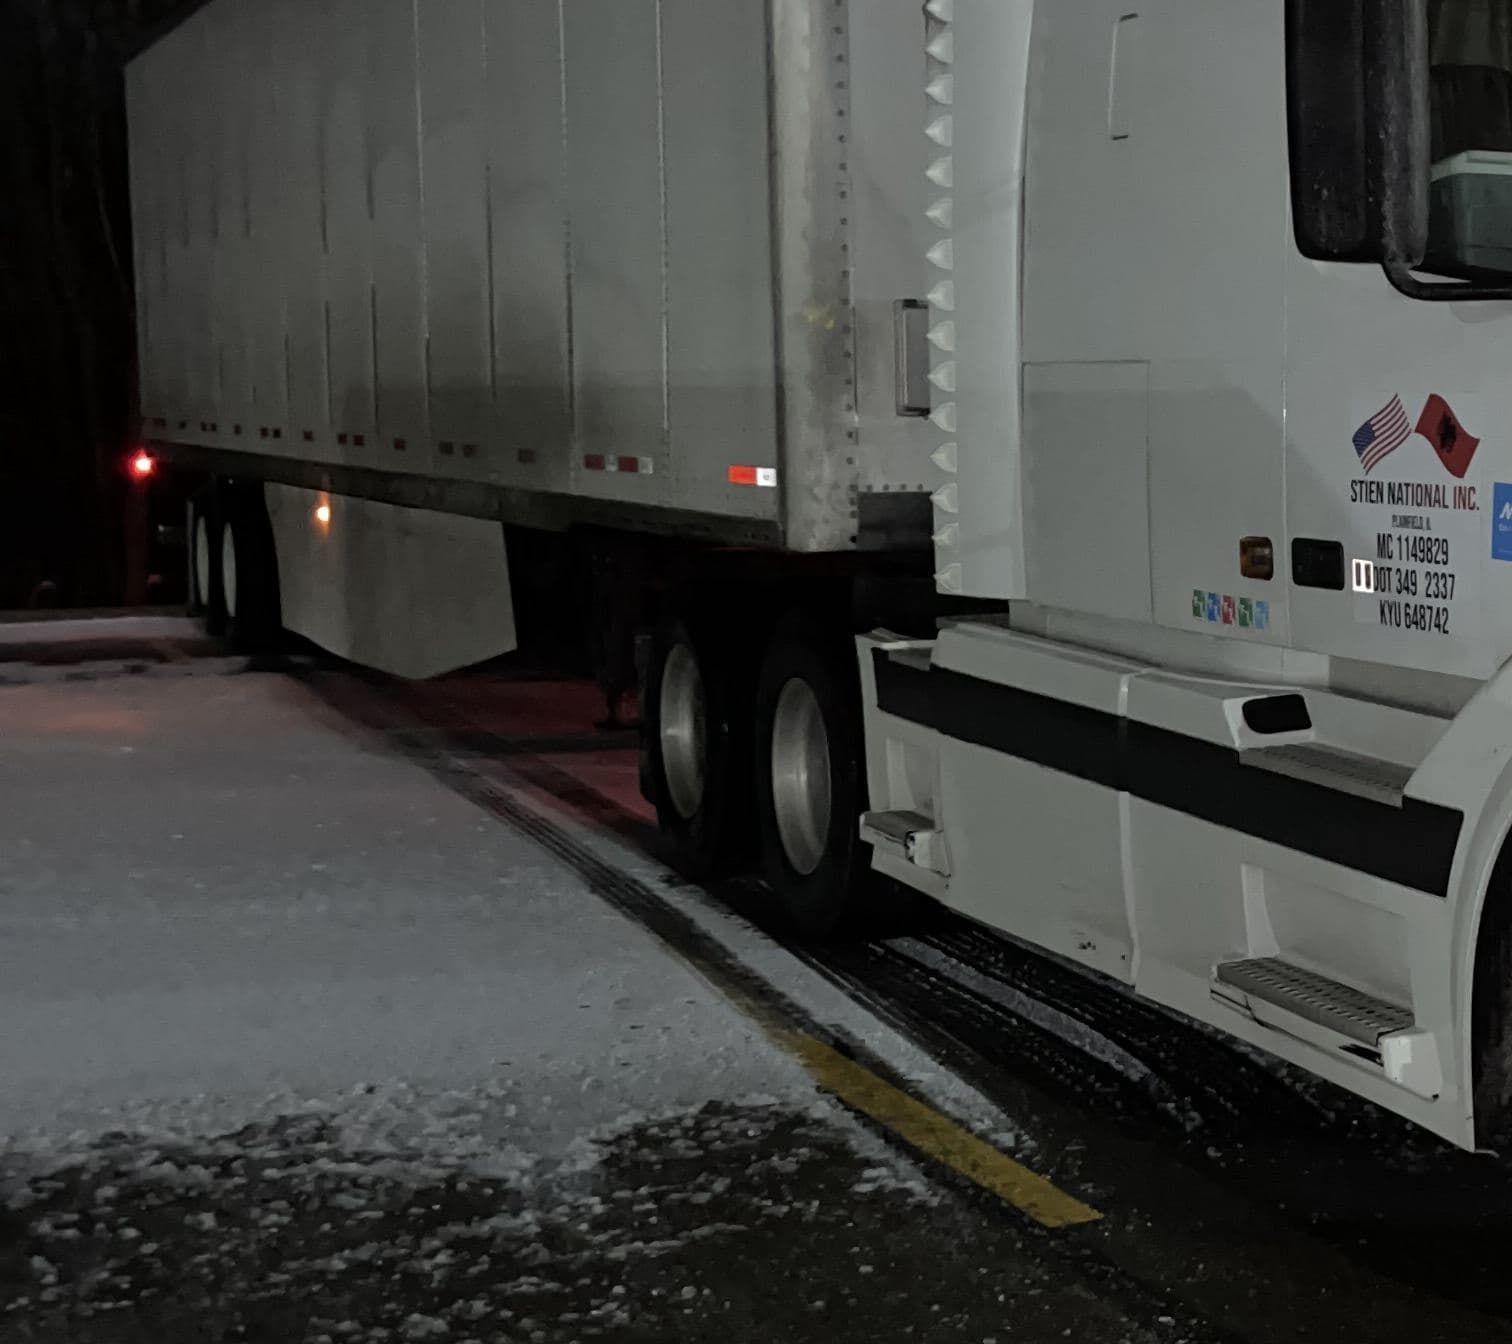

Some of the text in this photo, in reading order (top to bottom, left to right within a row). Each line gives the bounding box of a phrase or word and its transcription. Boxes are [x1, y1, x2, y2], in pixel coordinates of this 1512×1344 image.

[1350, 479, 1480, 511] STIEN NATIONAL INC.
[1376, 532, 1449, 565] MC 1149829
[1395, 567, 1418, 596] 349
[1425, 571, 1456, 601] 2337
[1379, 599, 1449, 635] KYU 648742
